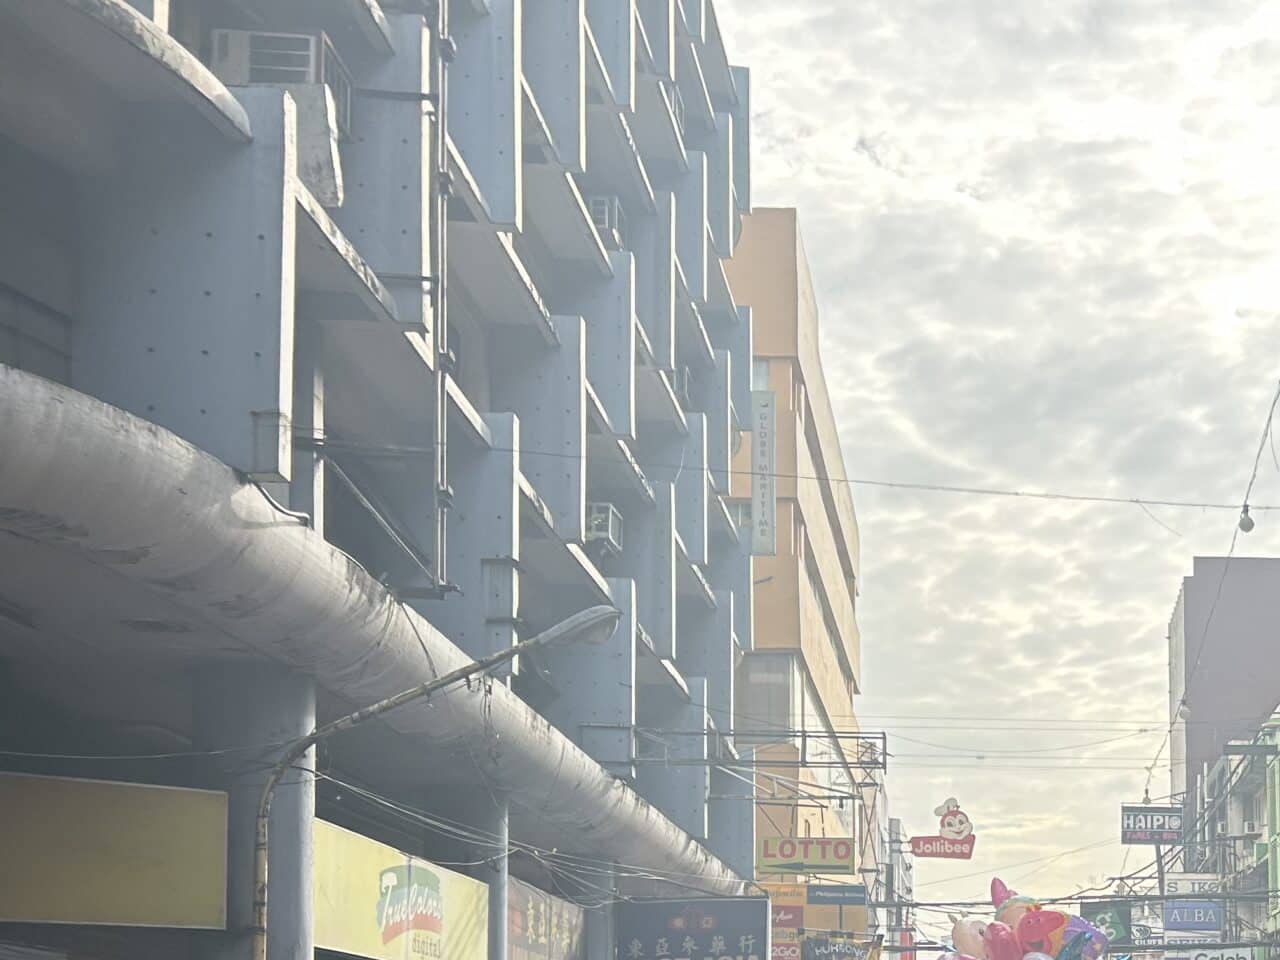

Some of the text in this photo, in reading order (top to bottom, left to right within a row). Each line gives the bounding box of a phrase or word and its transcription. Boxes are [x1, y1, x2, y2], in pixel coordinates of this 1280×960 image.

[758, 464, 769, 538] MARITIME
[763, 839, 851, 860] LOTTO
[914, 840, 970, 854] Jollibee
[1170, 909, 1217, 922] ALBA
[412, 933, 441, 959] digital
